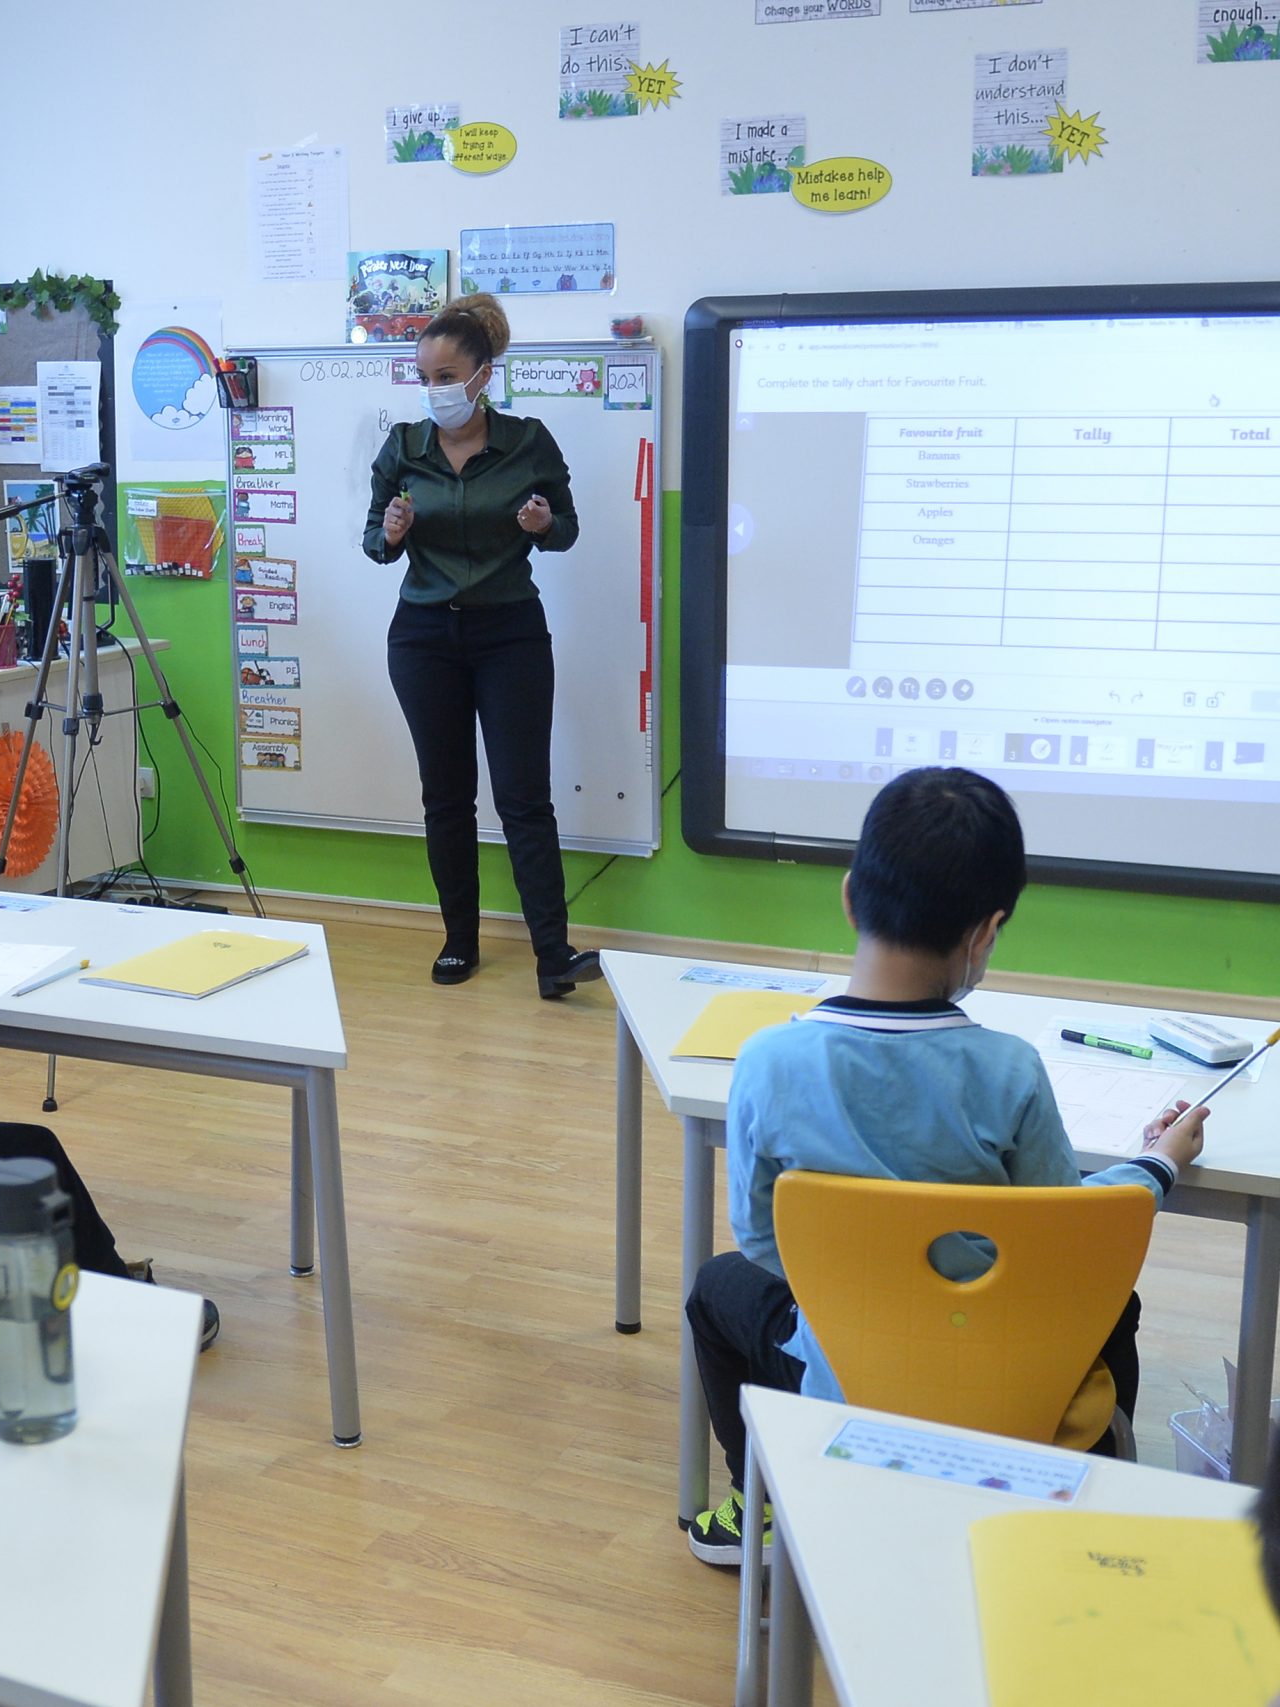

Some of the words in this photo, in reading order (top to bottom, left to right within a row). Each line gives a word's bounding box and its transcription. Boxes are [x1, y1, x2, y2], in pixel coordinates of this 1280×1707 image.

[765, 6, 799, 17] Change
[803, 4, 824, 15] your
[827, 0, 871, 11] WORDS
[569, 27, 583, 46] I
[589, 23, 635, 43] can't
[561, 56, 580, 74] do
[988, 57, 1002, 74] I
[1008, 54, 1053, 72] don't
[637, 76, 666, 95] YET
[975, 79, 1065, 100] understand
[402, 111, 423, 129] give
[464, 128, 478, 137] will
[479, 128, 499, 139] keep
[736, 123, 741, 140] I
[747, 121, 776, 139] made
[781, 124, 789, 136] a
[1057, 121, 1090, 147] YET
[462, 140, 485, 151] trying
[487, 141, 495, 149] in
[797, 170, 855, 185] Mistakes
[858, 167, 885, 184] help
[810, 191, 830, 203] me
[834, 187, 871, 201] learn!
[300, 360, 390, 382] 08.02.2021
[515, 368, 577, 382] February
[609, 371, 644, 390] 2021
[757, 378, 809, 390] Complete
[813, 377, 829, 388] the
[832, 377, 853, 390] tally
[857, 377, 883, 387] chart
[887, 376, 902, 387] for
[905, 376, 955, 388] Favourite
[959, 376, 986, 387] Fruit.
[257, 414, 288, 423] Morning
[900, 428, 953, 437] Favourite
[956, 427, 983, 440] fruit
[1074, 428, 1112, 444] Tally
[1230, 428, 1271, 441] Total
[918, 450, 961, 461] Bananas
[236, 476, 281, 489] Breather
[906, 479, 969, 489] Strawberries
[918, 507, 953, 519] Apples
[237, 533, 264, 546] Break
[913, 534, 955, 547] Oranges
[258, 566, 278, 574] Guided
[269, 602, 295, 611] English
[241, 634, 266, 647] Lunch
[241, 690, 287, 704] Breather
[270, 717, 298, 726] Phonics
[252, 741, 288, 753] Assembly
[944, 748, 952, 757] 2
[1141, 756, 1149, 765] 5
[1209, 760, 1217, 768] 6
